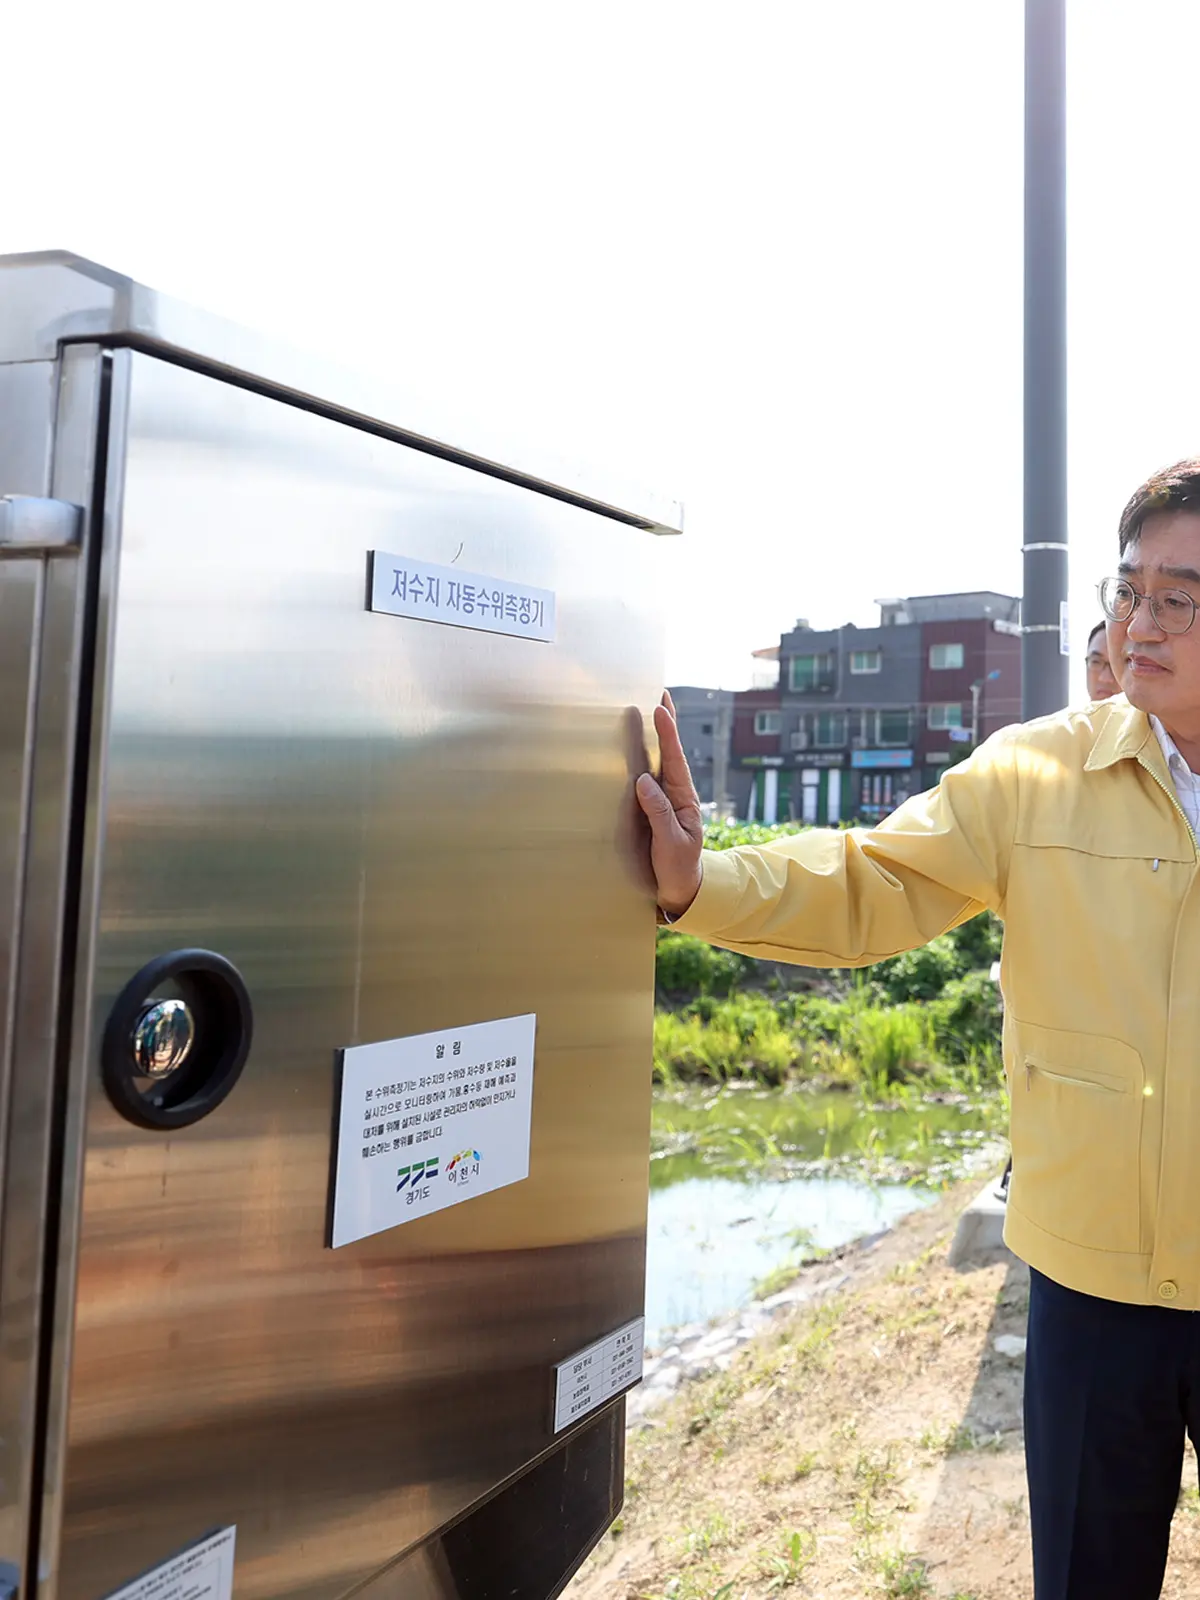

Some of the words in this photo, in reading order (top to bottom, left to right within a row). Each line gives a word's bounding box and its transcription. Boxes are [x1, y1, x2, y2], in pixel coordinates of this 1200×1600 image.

[391, 569, 439, 607] 저수지
[447, 582, 543, 627] 자동수위측정기
[436, 1044, 445, 1059] 알
[452, 1041, 461, 1055] 림
[365, 1090, 372, 1102] 본
[374, 1080, 416, 1099] 수위측정기는
[418, 1073, 444, 1089] 저수지의
[446, 1069, 465, 1082] 수위와
[467, 1064, 485, 1077] 저수량
[486, 1062, 492, 1072] 및
[494, 1057, 516, 1070] 저수율을
[362, 1124, 384, 1140] 대처를
[385, 1120, 399, 1133] 위해
[401, 1114, 421, 1129] 설치된
[423, 1108, 441, 1123] 시설로
[443, 1102, 467, 1117] 관리자의
[468, 1095, 491, 1110] 허락없이
[493, 1089, 515, 1104] 만지거나
[364, 1101, 401, 1121] 실시간으로
[404, 1090, 445, 1110] 모니터링하여
[361, 1141, 390, 1159] 훼손하는
[392, 1134, 413, 1149] 행위를
[406, 1186, 430, 1204] 경기도
